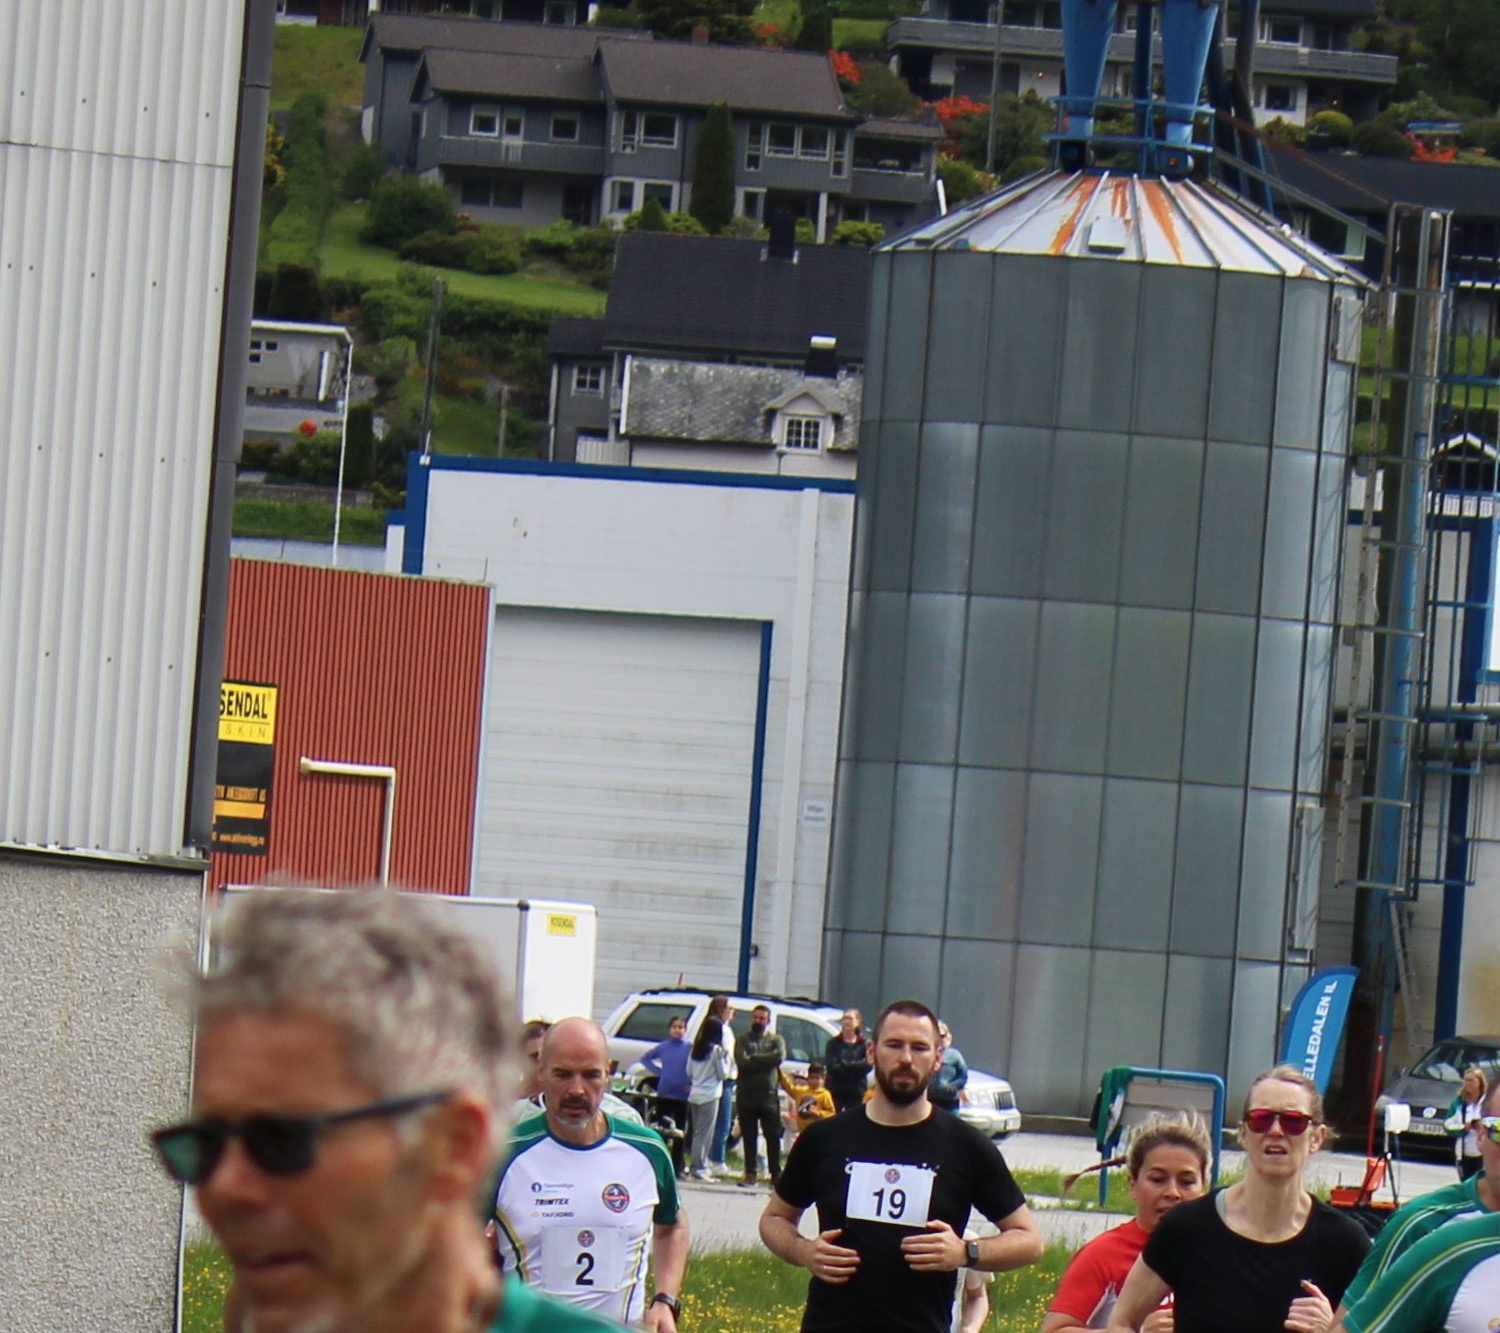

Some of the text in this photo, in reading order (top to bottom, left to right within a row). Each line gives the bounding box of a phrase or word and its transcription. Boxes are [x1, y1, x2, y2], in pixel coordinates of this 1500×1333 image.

[535, 1198, 570, 1206] TRIMTEX
[873, 1188, 906, 1219] 19
[575, 1252, 595, 1286] 2
